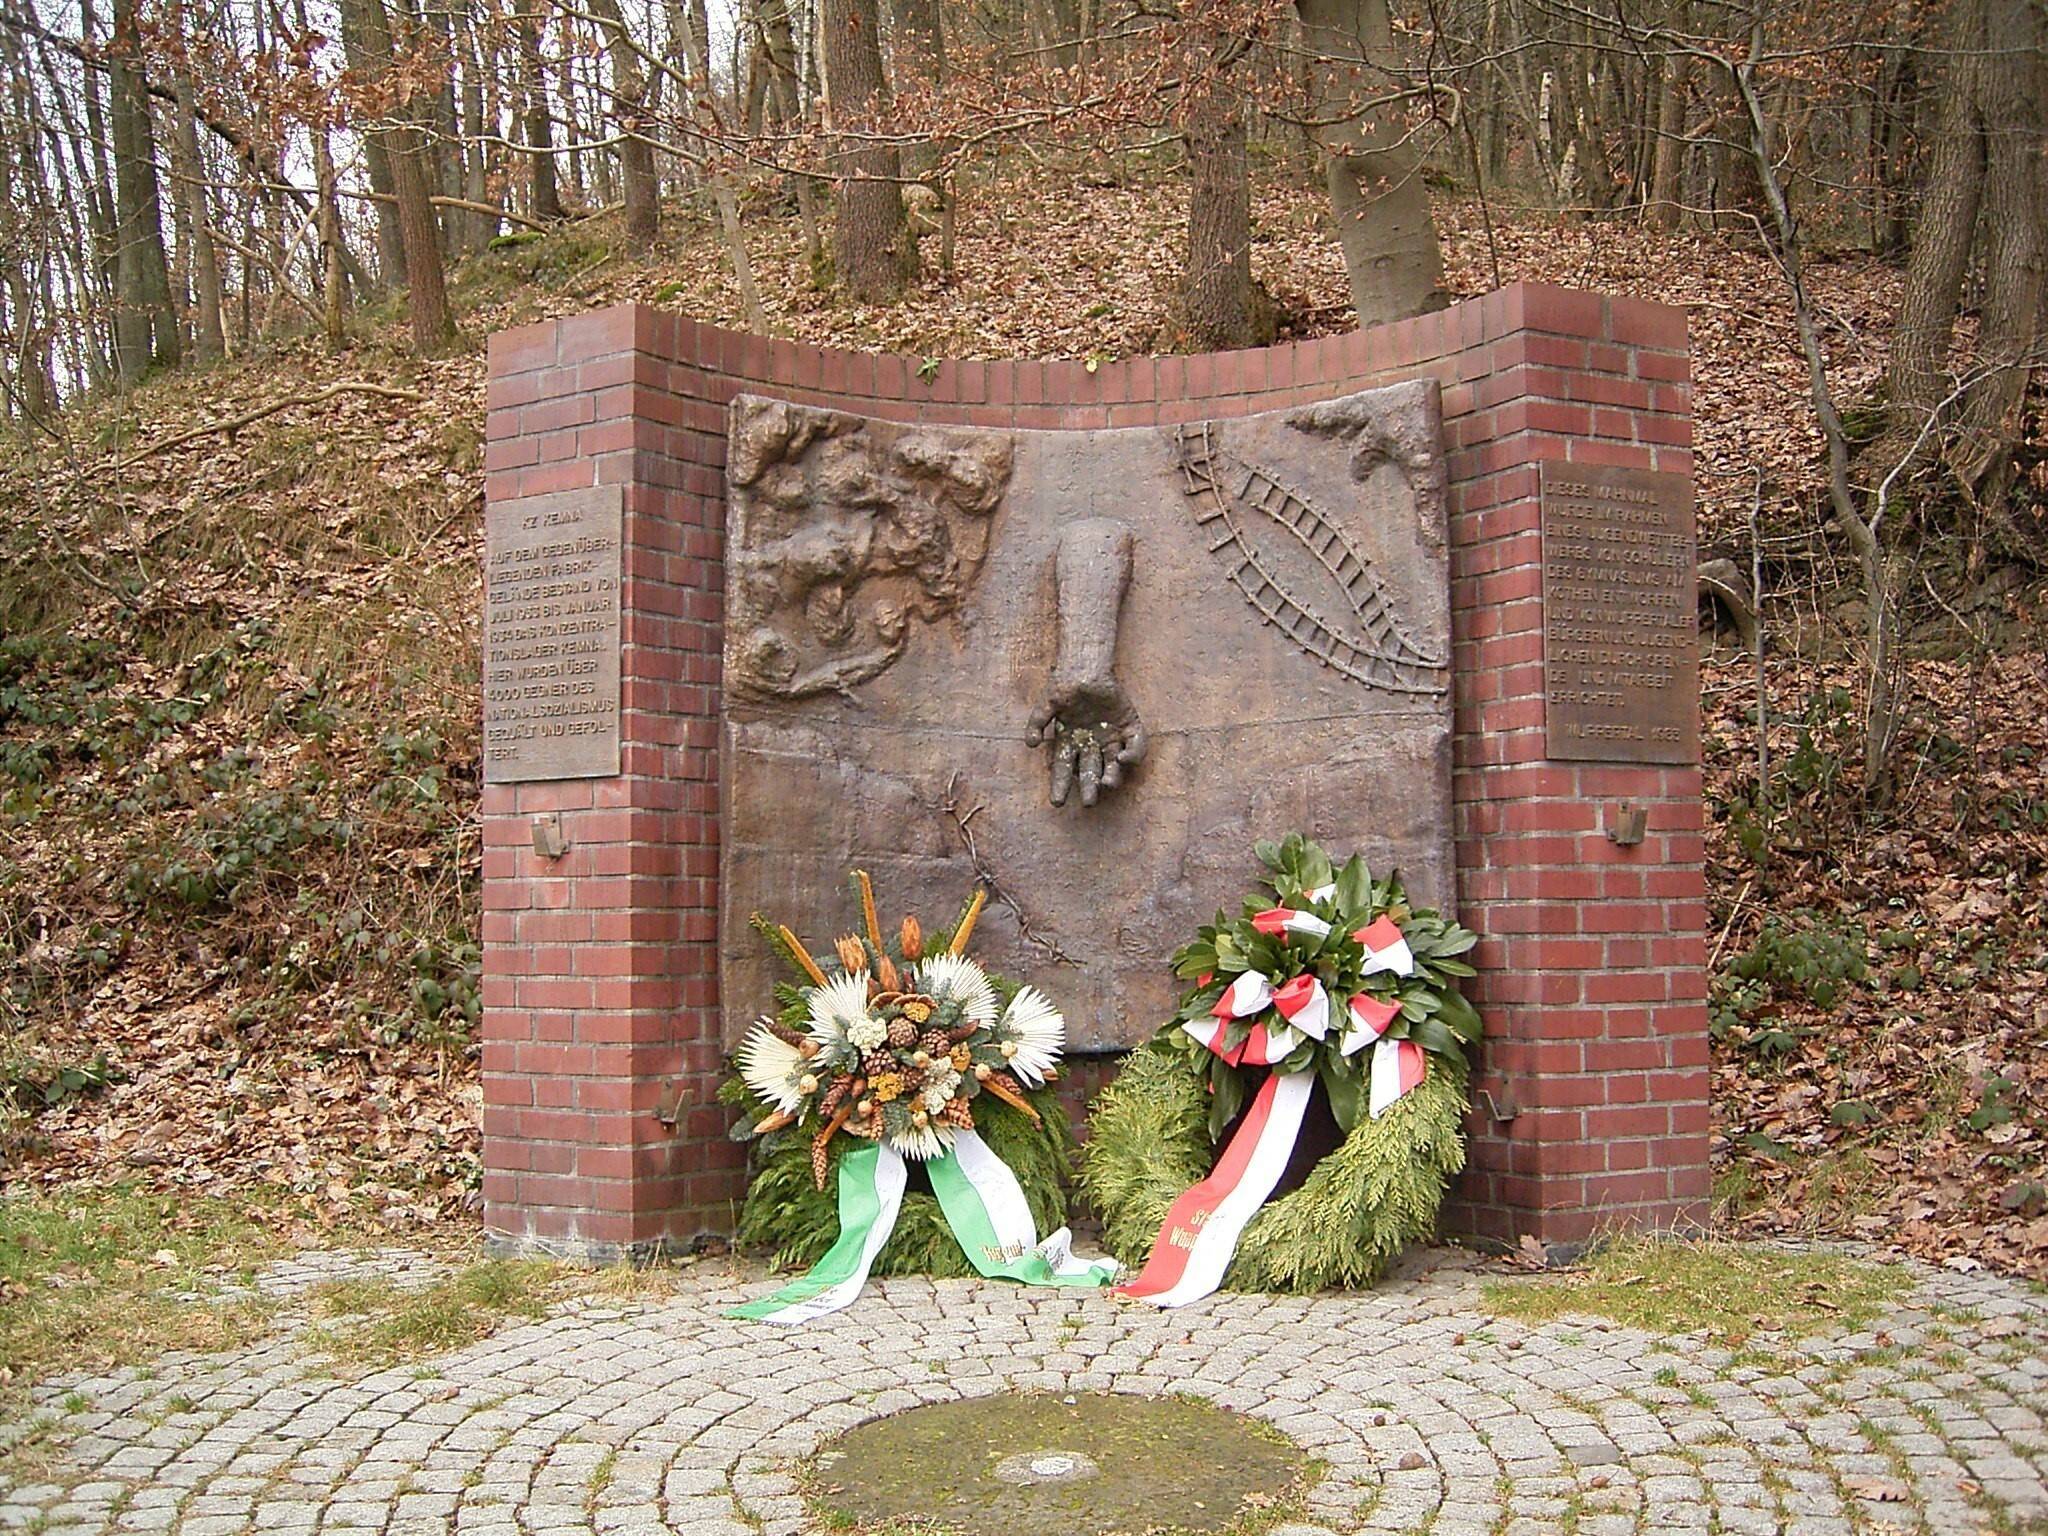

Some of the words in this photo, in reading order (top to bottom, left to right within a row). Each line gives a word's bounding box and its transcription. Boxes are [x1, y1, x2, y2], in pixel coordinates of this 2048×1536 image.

[1546, 481, 1590, 499] DIESES
[1595, 485, 1659, 506] MAHNMAL
[544, 510, 583, 528] KEMNA
[1547, 502, 1592, 520] WURDE
[1616, 508, 1668, 527] RAHMEN
[1546, 522, 1582, 540] EINES
[490, 550, 513, 565] AUF
[515, 546, 539, 562] DEM
[542, 536, 617, 559] GEGENÜBER-
[1597, 548, 1620, 563] VON
[1623, 547, 1690, 568] SCHÜLERN
[490, 565, 549, 586] LIEGENDEN
[551, 560, 599, 578] FABRIK-
[1548, 563, 1572, 580] DES
[1576, 566, 1660, 587] GYMNASIUMS
[1666, 572, 1684, 588] AM
[490, 586, 540, 605] GELÄNDE
[542, 581, 591, 599] BESTAND
[598, 577, 619, 591] VON
[1602, 589, 1681, 608] ENTWORFEN
[490, 608, 514, 624] JULI
[516, 605, 540, 620] 1933
[543, 603, 561, 618] BIS
[565, 597, 611, 615] JANUAR
[1548, 606, 1573, 622] UND
[1579, 607, 1602, 623] VON
[1604, 609, 1695, 629] WUPPERTALER
[490, 629, 513, 643] 1934
[515, 625, 537, 640] DAS
[540, 619, 617, 639] KONZENTRA-
[1549, 621, 1609, 644] BÜRGERN
[1611, 631, 1635, 646] UND
[489, 643, 558, 662] TIONSLAGER
[1549, 647, 1595, 664] LICHEN
[1600, 650, 1642, 668] DURCH
[488, 668, 513, 682] HIER
[517, 663, 564, 680] WURDEN
[567, 658, 598, 674] ÜBER
[1579, 671, 1605, 686] UND
[1609, 672, 1674, 689] MITARBEIT
[487, 686, 520, 701] 4000
[523, 682, 568, 699] GEGNER
[571, 681, 595, 695] DES
[488, 698, 615, 721] NATIONALSOZIALISMUS
[488, 723, 536, 741] GEQUÄLT
[541, 722, 564, 737] UND
[568, 720, 614, 735] GEFOL-
[1565, 723, 1645, 741] WUPPERTAL
[488, 746, 519, 760] TERT.
